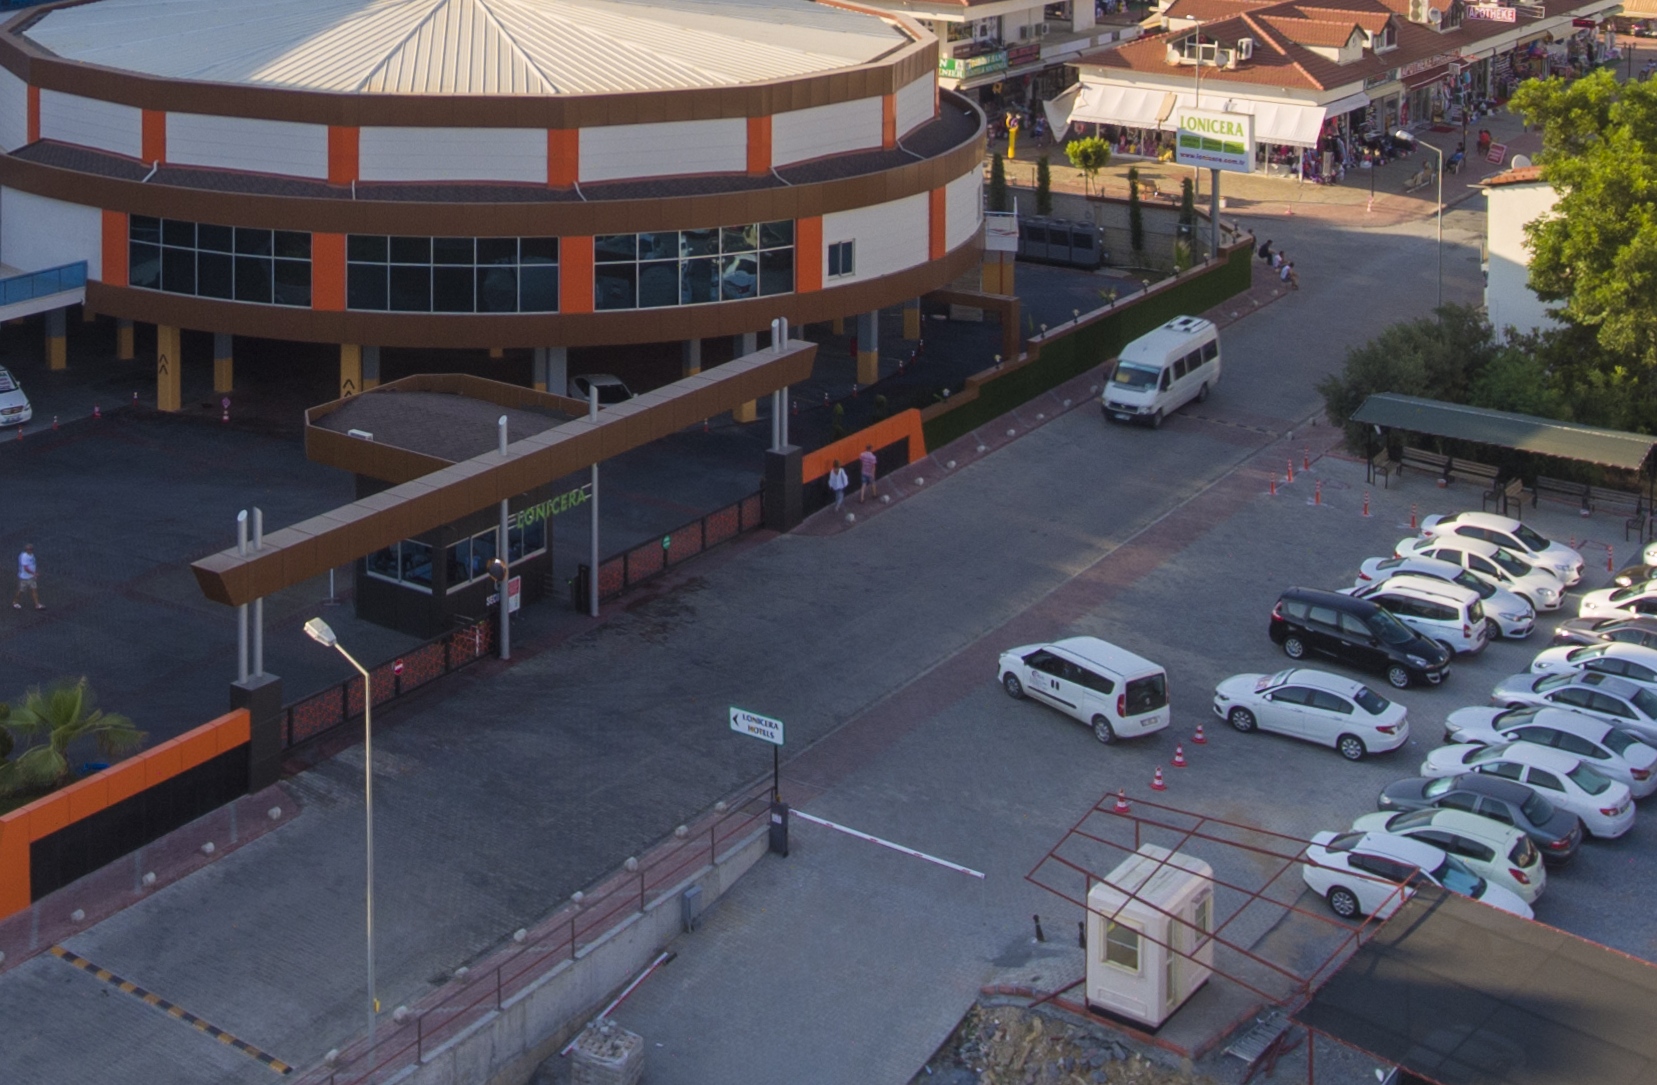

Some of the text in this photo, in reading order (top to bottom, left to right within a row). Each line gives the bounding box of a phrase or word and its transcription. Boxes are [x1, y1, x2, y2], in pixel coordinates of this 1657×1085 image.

[1469, 6, 1514, 21] APOTHEKE
[1180, 115, 1244, 136] LONICERA
[517, 489, 586, 529] LONICERA
[742, 713, 779, 731] LONICERA
[747, 725, 774, 739] HOTELS
